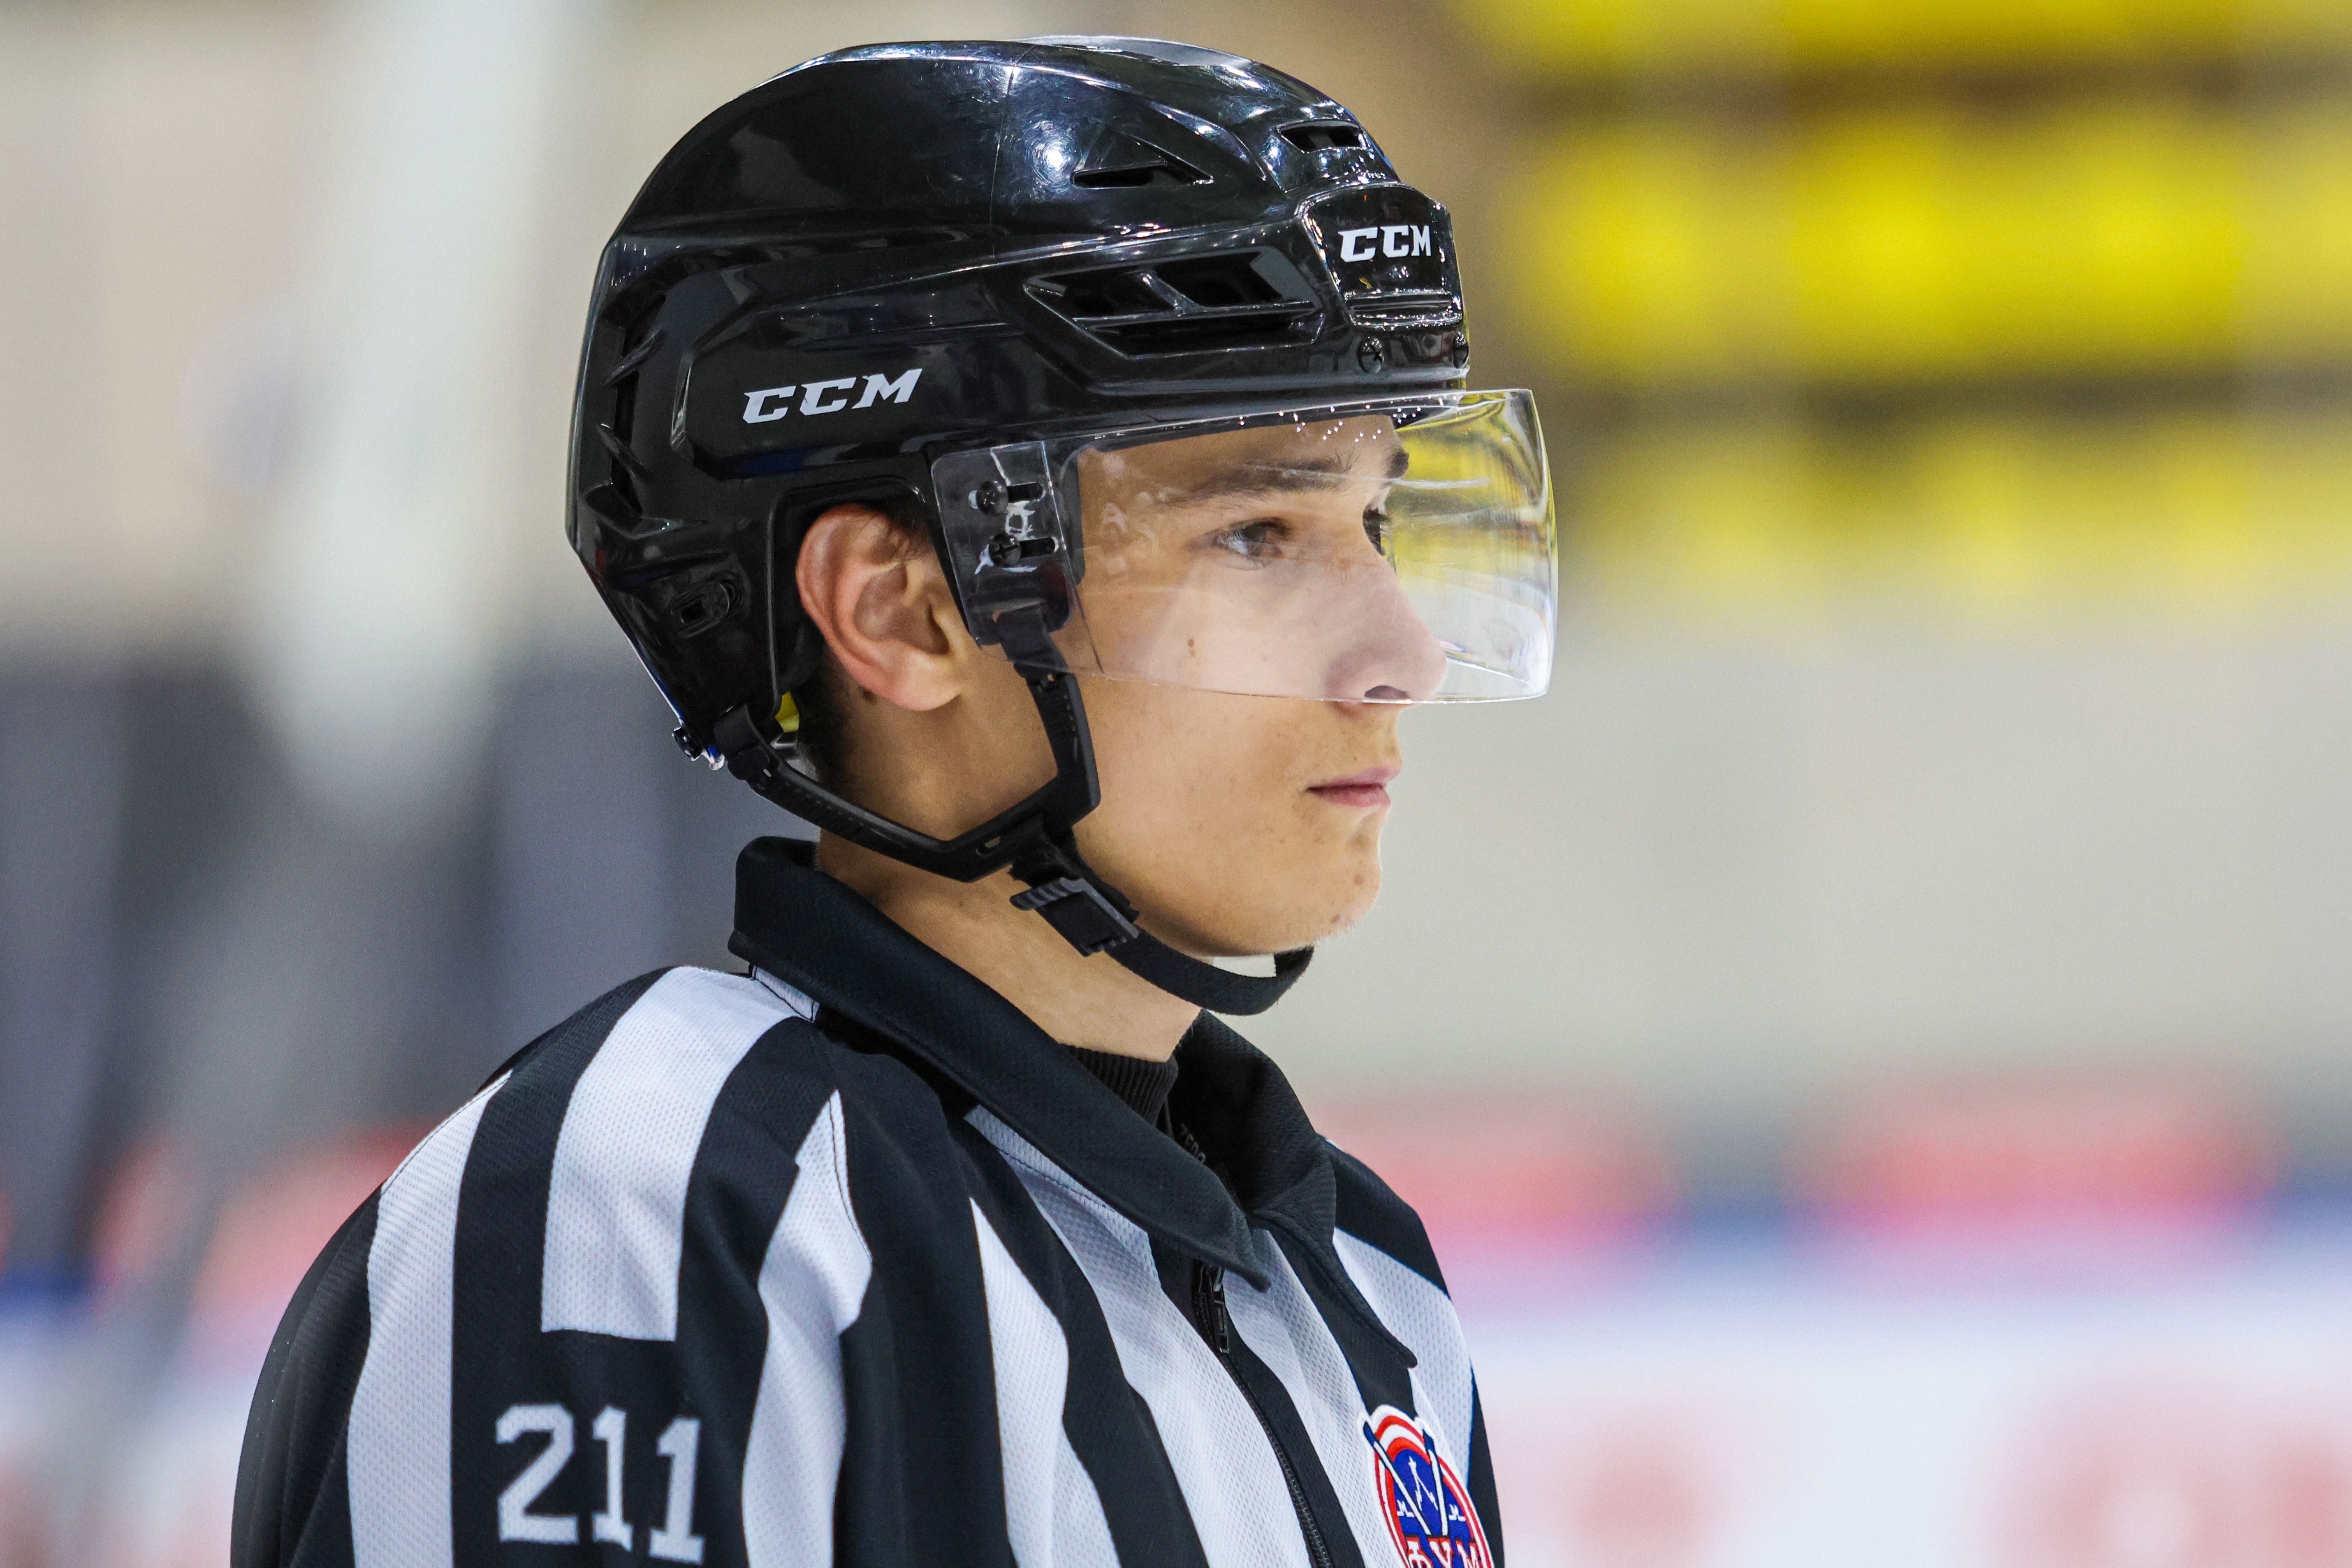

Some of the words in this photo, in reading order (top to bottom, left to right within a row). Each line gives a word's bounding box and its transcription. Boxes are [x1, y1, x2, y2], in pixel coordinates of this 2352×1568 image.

[1338, 225, 1432, 262] CCM
[743, 368, 922, 424] CCM
[495, 1404, 704, 1563] 211
